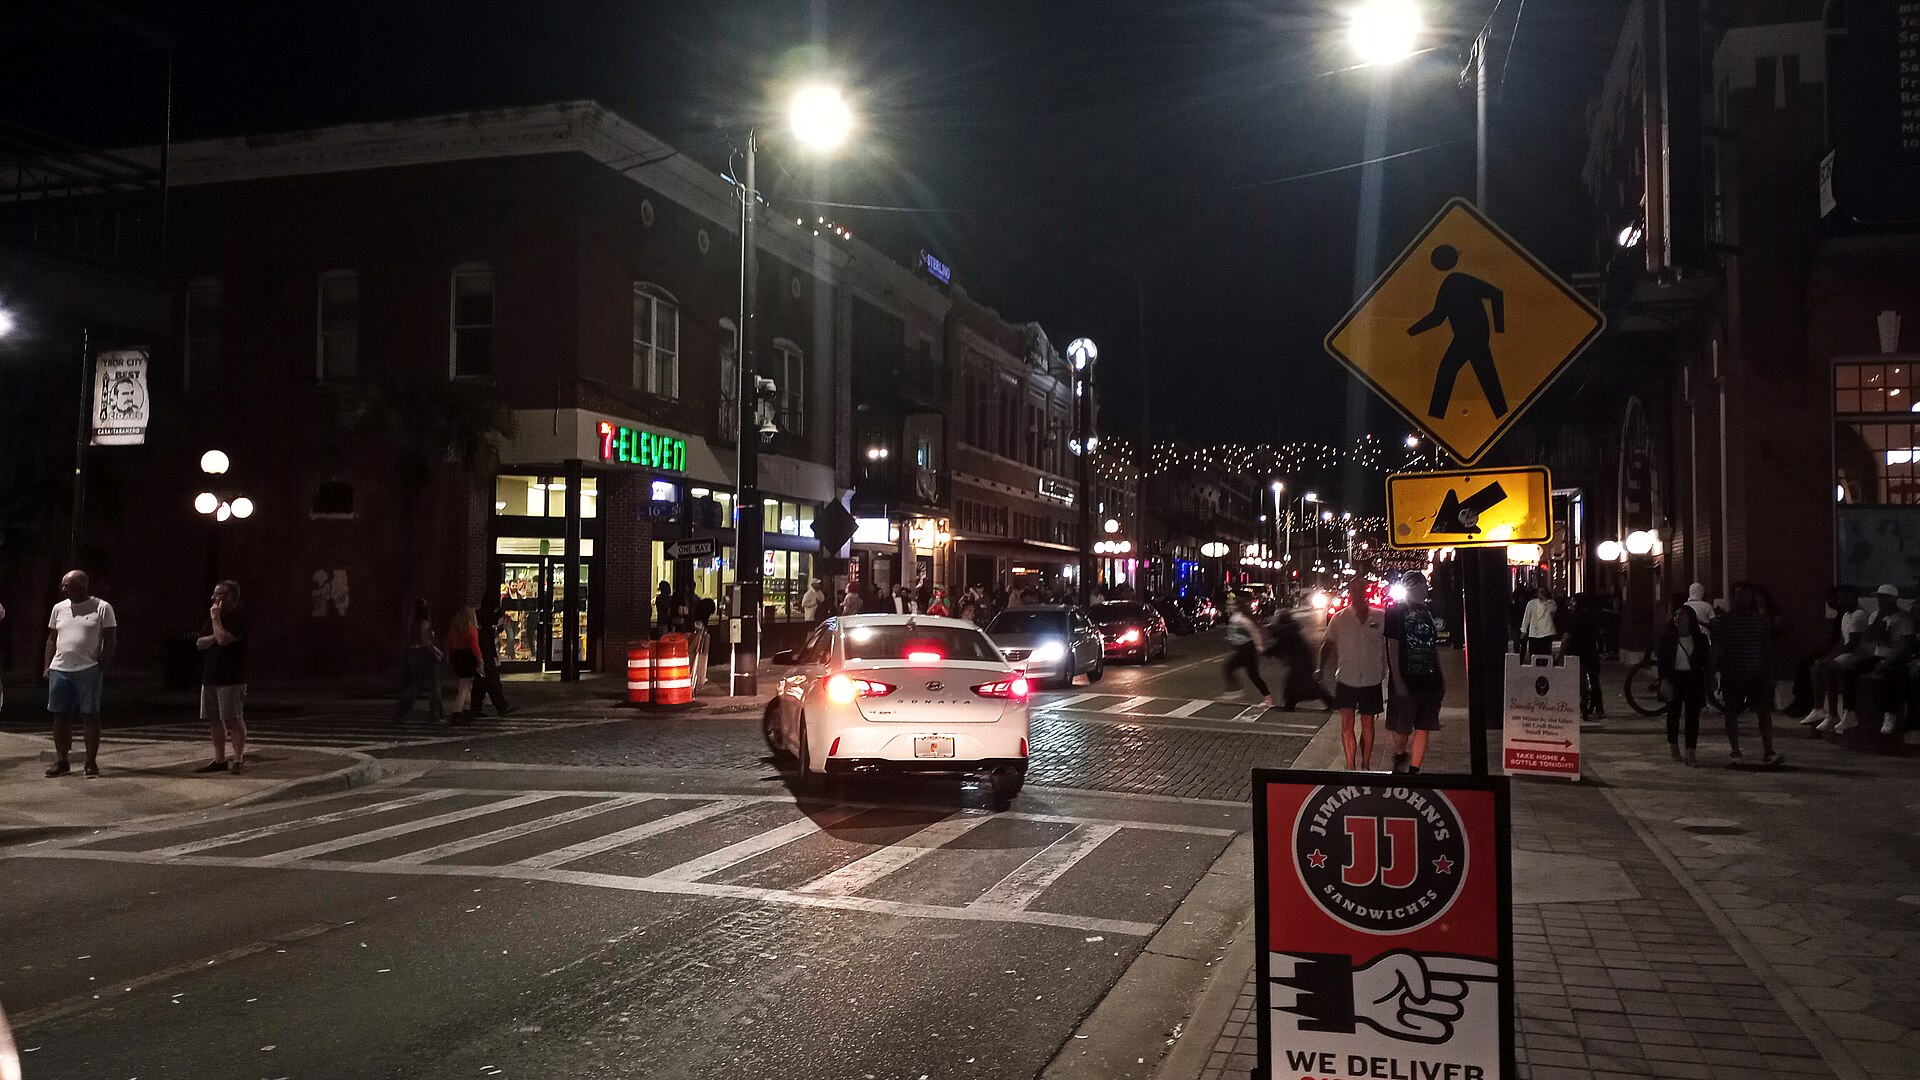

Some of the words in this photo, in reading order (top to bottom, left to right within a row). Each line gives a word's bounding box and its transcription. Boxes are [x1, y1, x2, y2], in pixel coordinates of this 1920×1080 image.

[126, 358, 143, 367] CITY
[115, 371, 140, 379] BEST
[693, 543, 709, 553] WAY
[1510, 758, 1537, 767] BOTTLE
[1382, 787, 1450, 842] JOHN'S
[1341, 814, 1419, 889] JJ
[1323, 883, 1438, 920] SANDWICHES
[1286, 1050, 1337, 1075] WE
[1347, 1054, 1485, 1080] DELIVER
